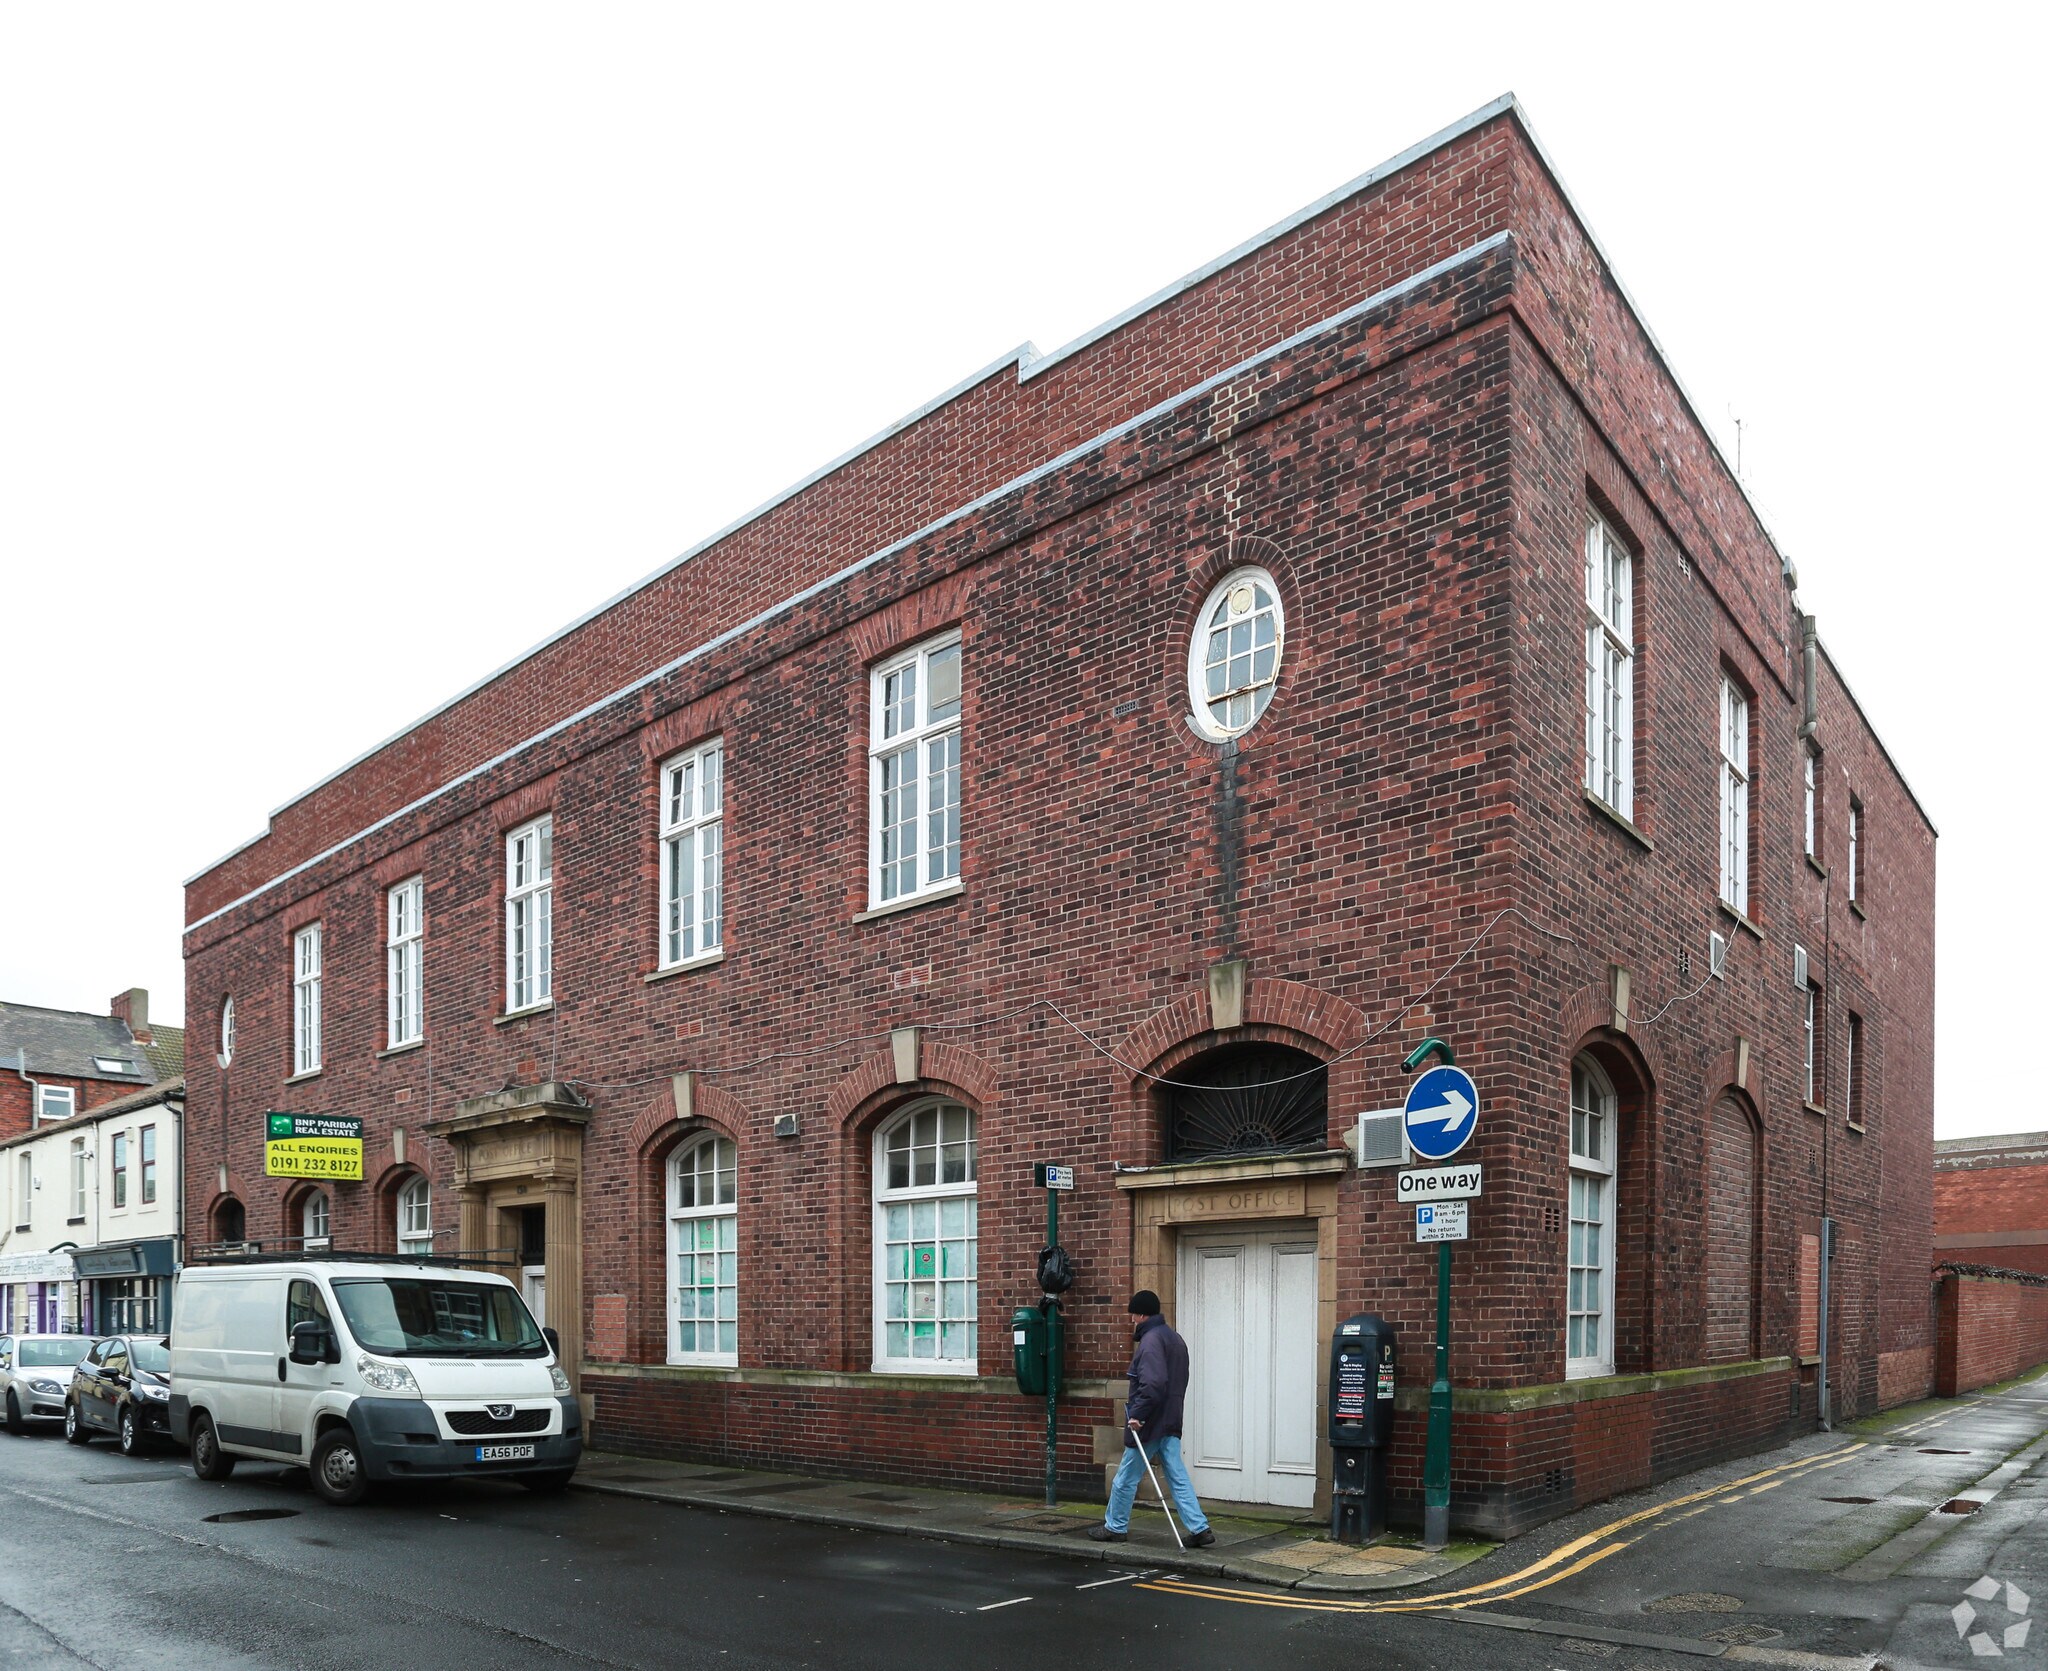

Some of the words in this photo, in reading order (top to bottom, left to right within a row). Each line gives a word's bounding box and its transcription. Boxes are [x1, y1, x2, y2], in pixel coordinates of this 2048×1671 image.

[295, 1118, 316, 1127] BNP
[318, 1120, 358, 1130] PARIBAS
[295, 1127, 320, 1135] REAL
[322, 1128, 356, 1136] ESTATE
[272, 1144, 296, 1152] ALL
[298, 1145, 358, 1155] ENQIRIES
[271, 1157, 298, 1169] 0191
[304, 1158, 326, 1170] 232
[330, 1160, 358, 1172] 8127
[1400, 1175, 1437, 1192] One
[1441, 1173, 1480, 1190] way
[1173, 1196, 1218, 1212] POST
[1228, 1190, 1295, 1209] OFFICE
[1421, 1210, 1430, 1222] P
[1384, 1345, 1390, 1360] P
[484, 1448, 510, 1458] EA56
[513, 1446, 532, 1456] POF
